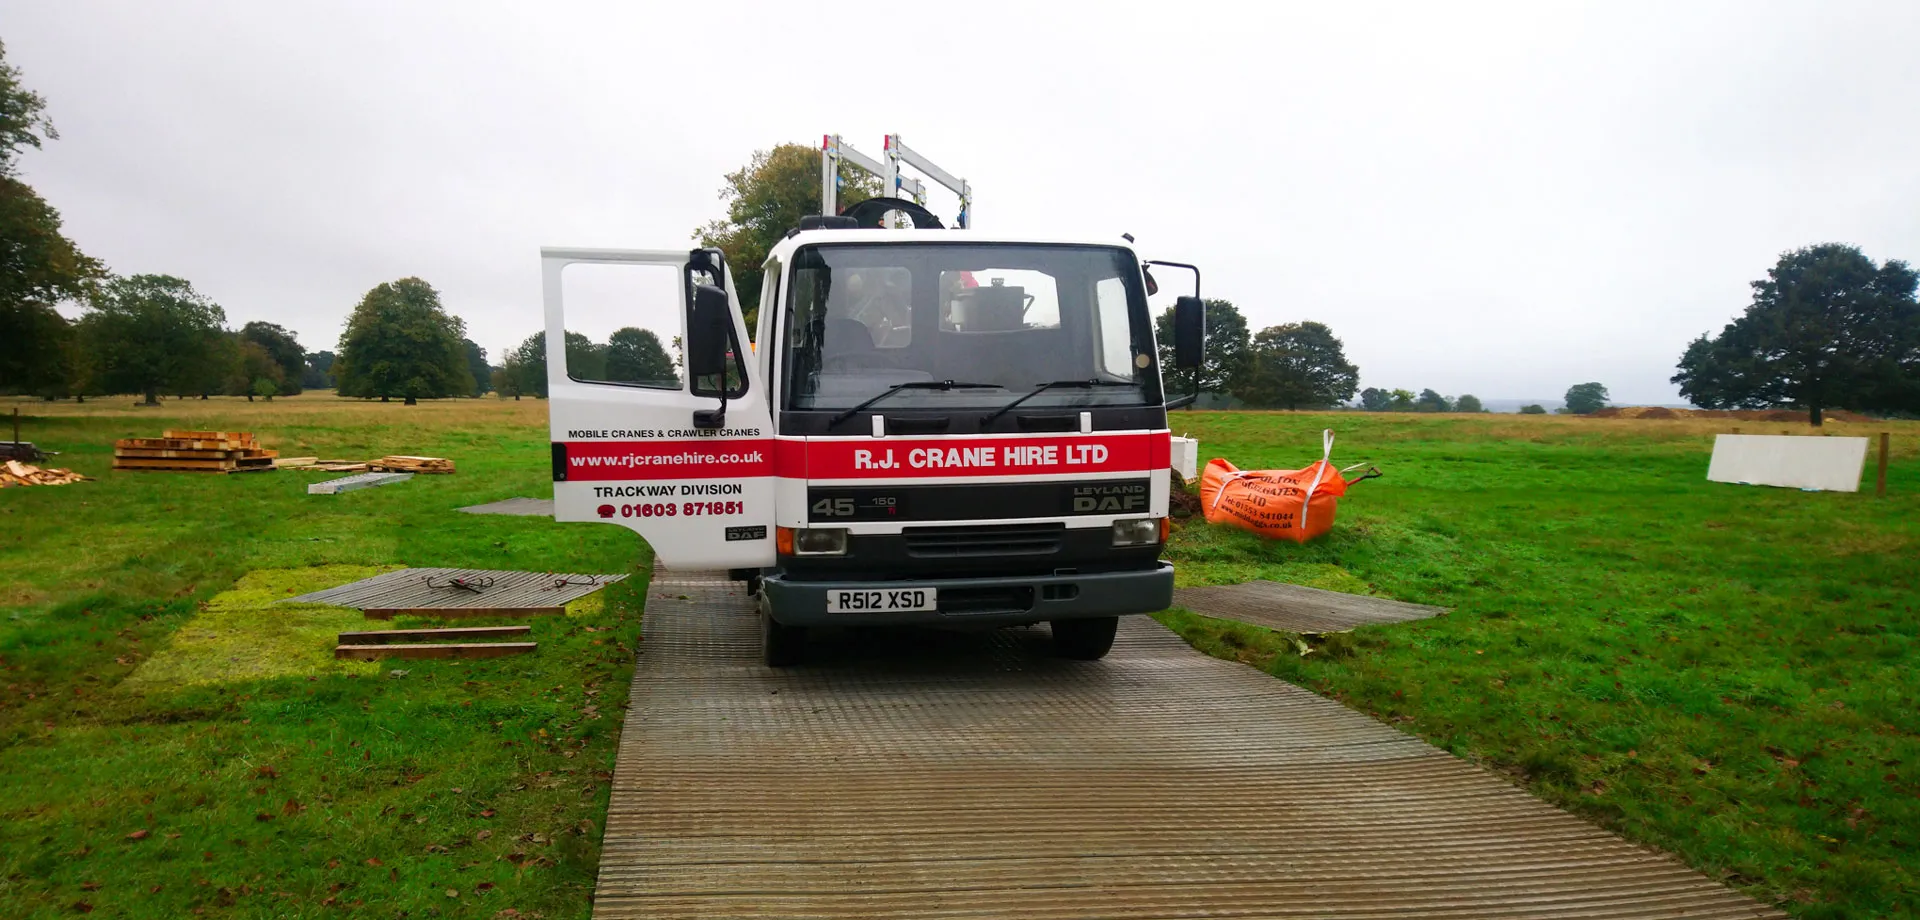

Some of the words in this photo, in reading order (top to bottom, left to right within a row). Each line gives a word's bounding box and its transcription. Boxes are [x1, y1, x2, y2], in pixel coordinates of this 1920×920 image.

[568, 429, 609, 439] MOBILE
[611, 429, 655, 438] CRANES
[657, 429, 665, 438] &
[667, 428, 717, 438] CRAWLER
[719, 428, 761, 437] CRANES
[570, 450, 763, 468] www.rjcranehire.co.uk
[854, 449, 900, 469] R.J.
[908, 447, 996, 468] CRANE
[1003, 445, 1059, 467] HIRE
[1065, 444, 1109, 465] LTD
[593, 485, 677, 498] TRACKWAY
[681, 484, 742, 496] DIVISION
[1073, 485, 1146, 495] LEYLAND
[621, 503, 677, 518] 01603
[683, 501, 744, 517] 871851
[812, 498, 855, 517] 45
[872, 497, 897, 505] 150
[1073, 495, 1146, 512] DAF
[728, 531, 765, 540] DAF
[839, 592, 883, 609] R512
[887, 591, 925, 608] XSD
